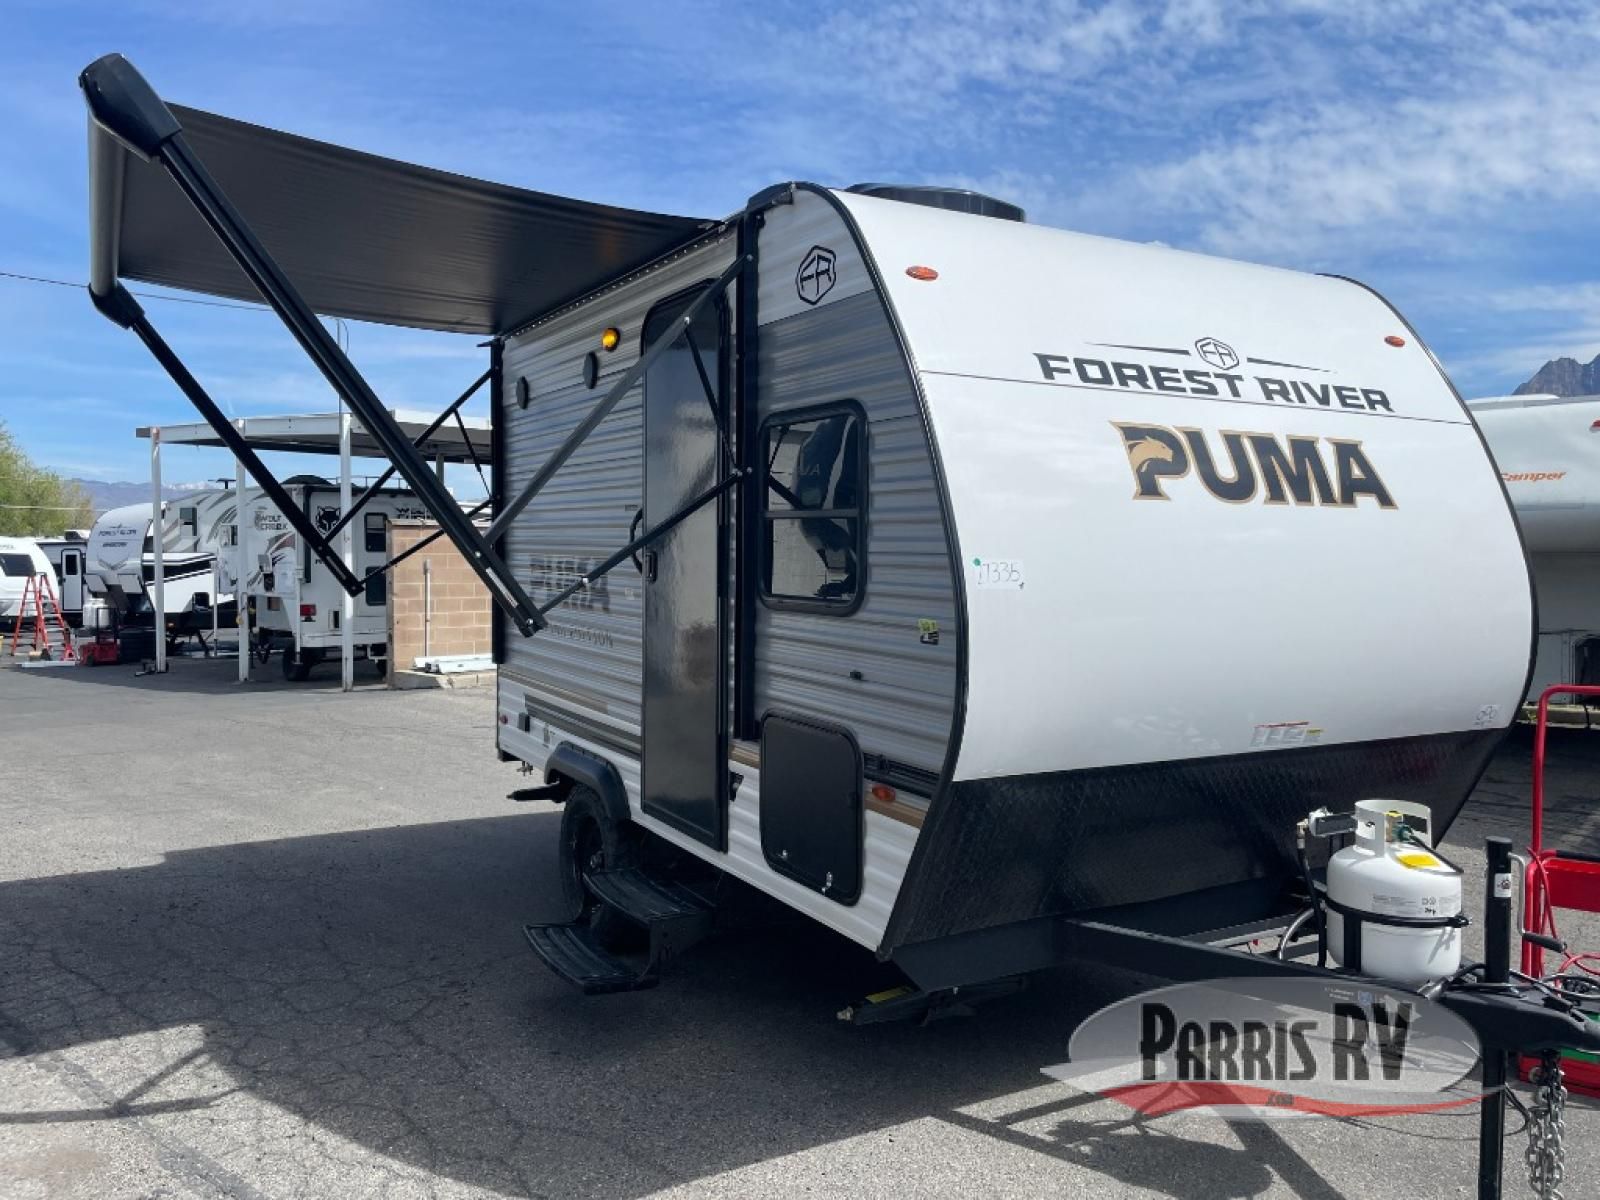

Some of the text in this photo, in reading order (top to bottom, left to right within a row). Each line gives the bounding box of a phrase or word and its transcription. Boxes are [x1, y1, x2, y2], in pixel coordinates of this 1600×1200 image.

[1032, 352, 1395, 413] FOREST RIVER
[1108, 420, 1399, 510] PUMA
